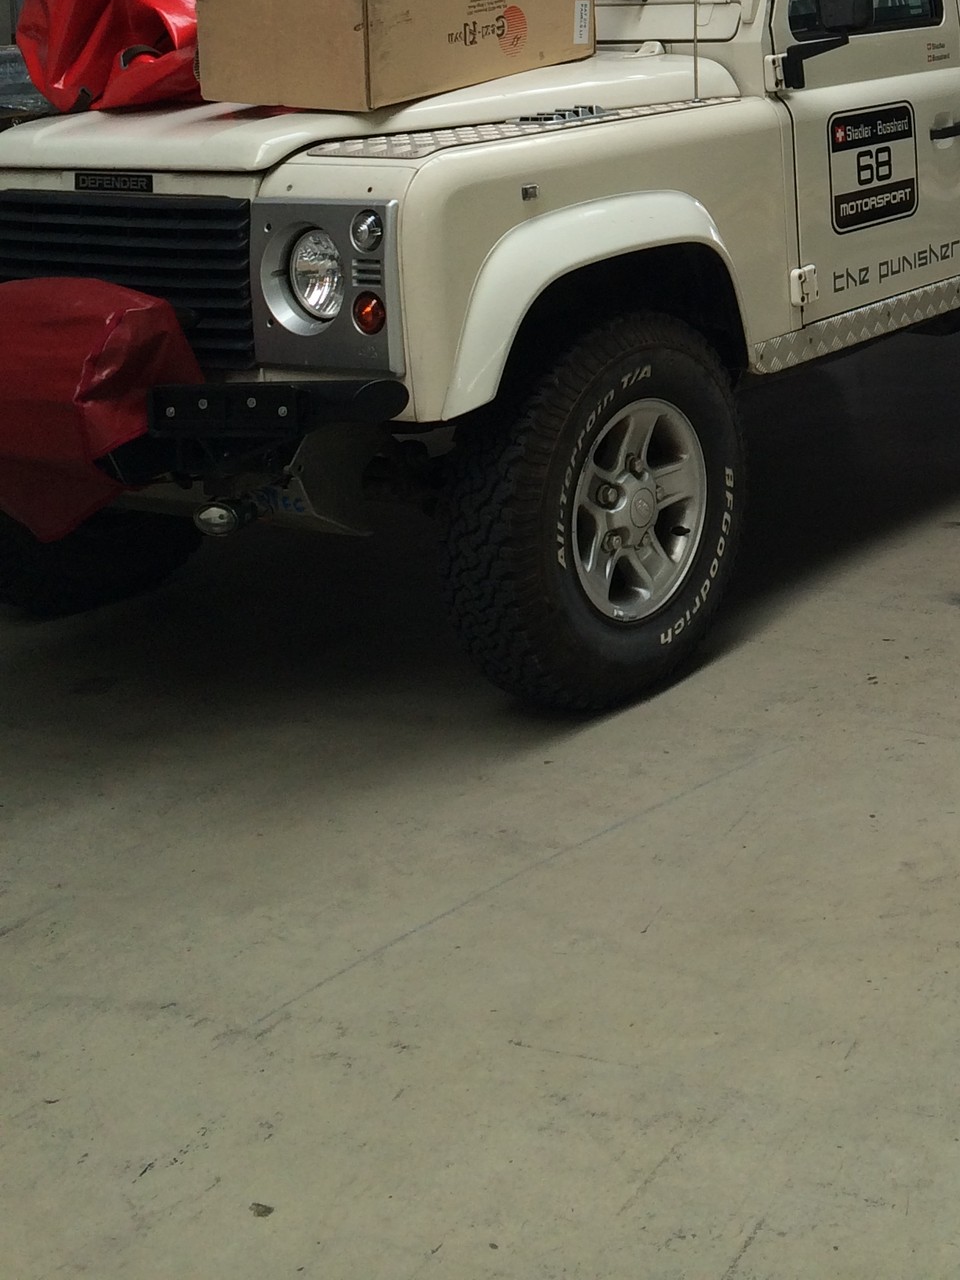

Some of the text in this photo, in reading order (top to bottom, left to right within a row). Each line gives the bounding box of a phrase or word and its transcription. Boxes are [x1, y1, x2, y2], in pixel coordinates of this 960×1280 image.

[877, 116, 909, 136] Bosshard
[856, 146, 893, 187] 68
[79, 175, 148, 190] DEFENDER
[840, 188, 912, 217] MOTORSPORT
[833, 240, 960, 293] the punisher
[621, 364, 652, 390] T/A
[660, 466, 735, 646] BFGoodrich
